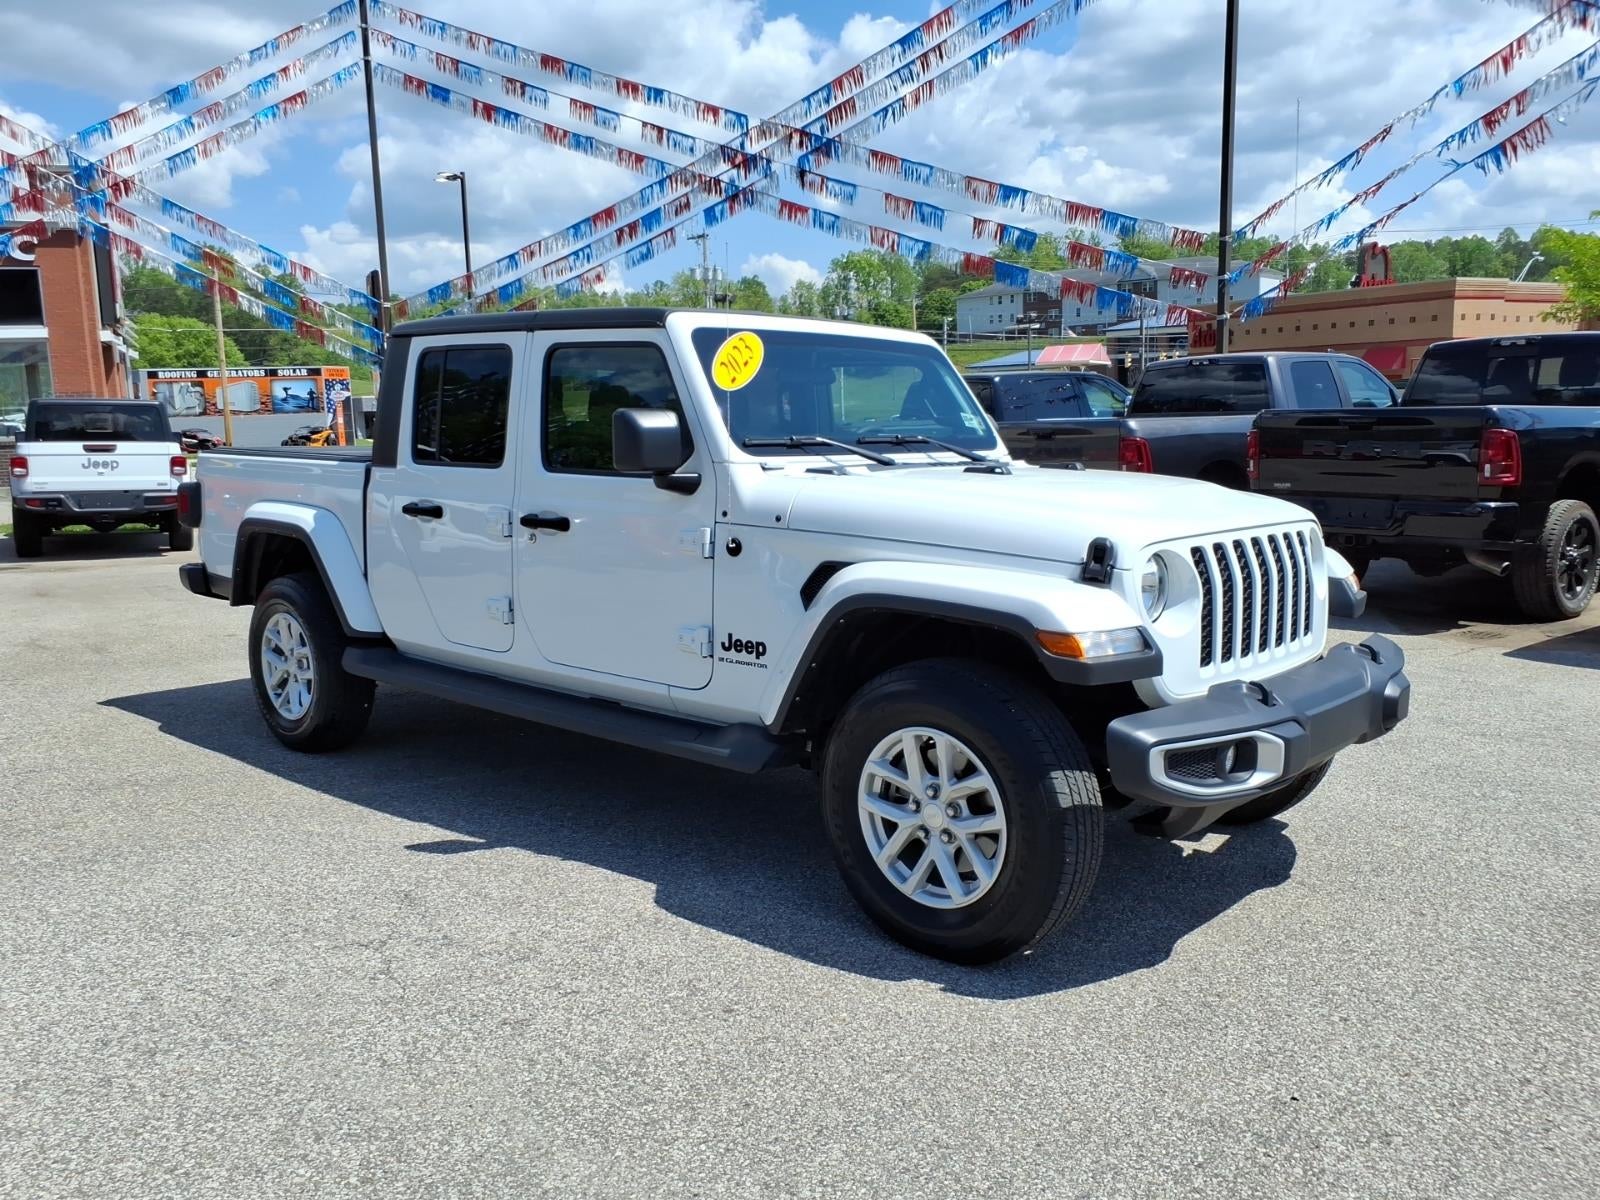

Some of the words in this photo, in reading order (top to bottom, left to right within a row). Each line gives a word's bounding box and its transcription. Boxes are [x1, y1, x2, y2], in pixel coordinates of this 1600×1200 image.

[720, 337, 753, 384] 2023
[207, 369, 265, 378] GEERATORS
[278, 368, 308, 377] SOLAR
[81, 457, 119, 471] Jeep
[720, 632, 767, 660] Jeep
